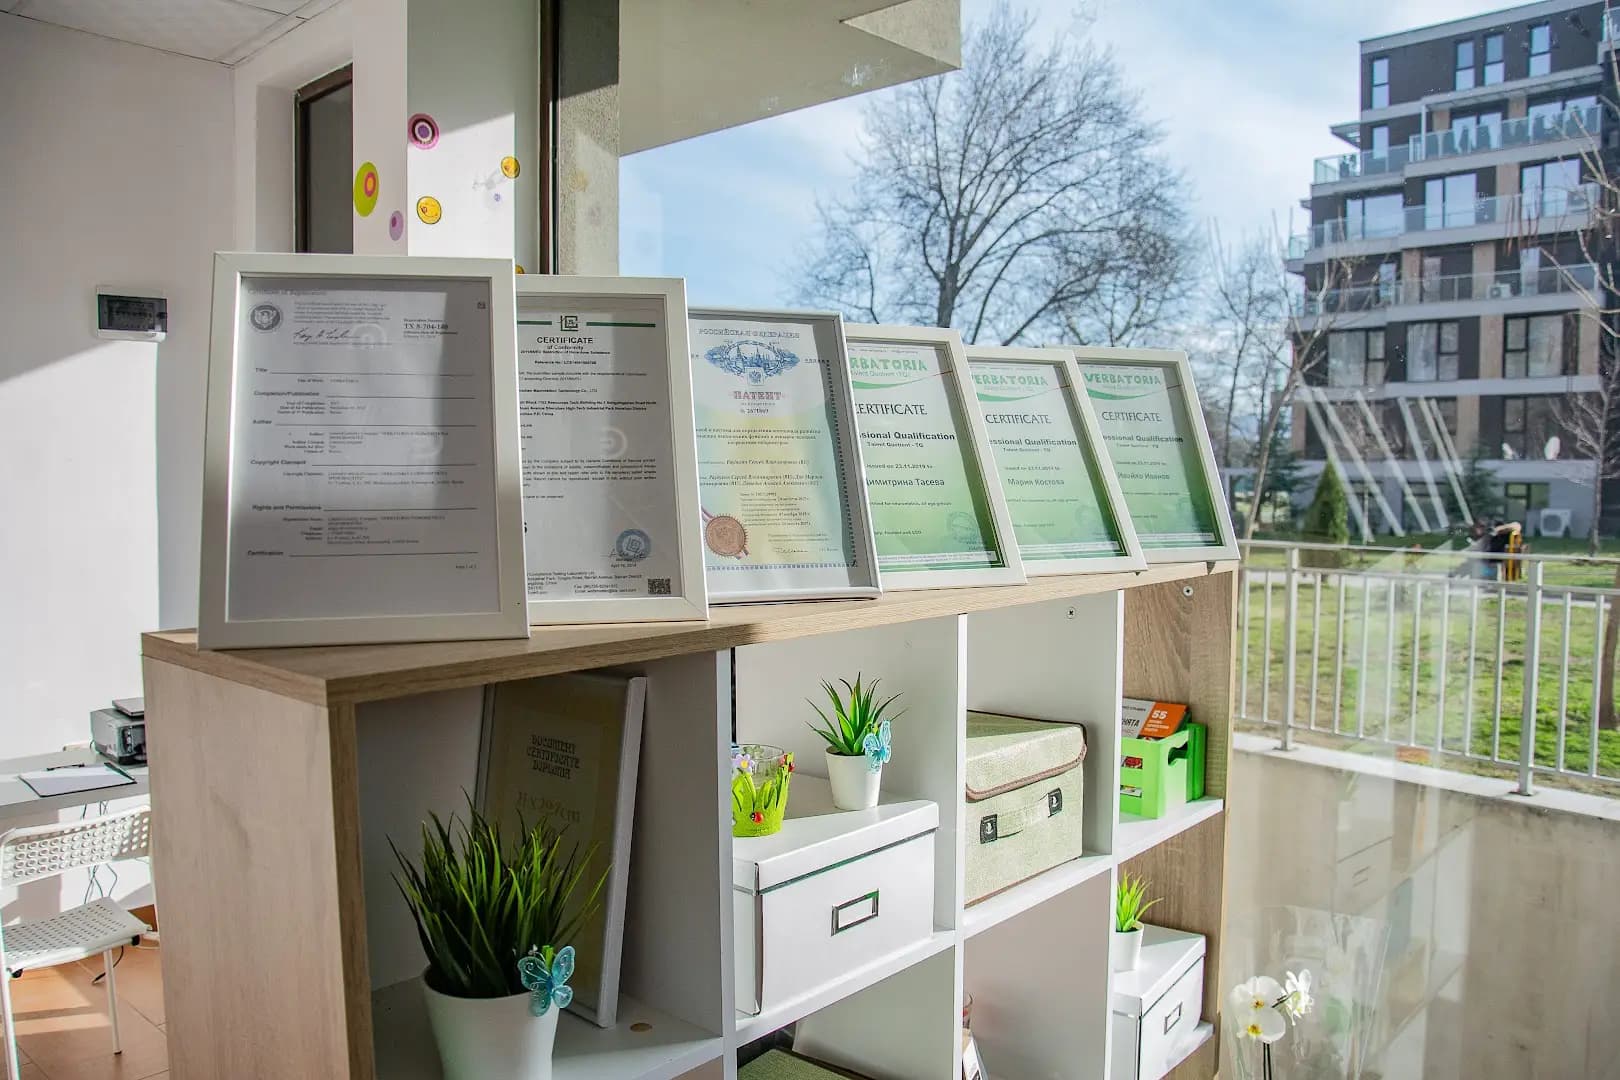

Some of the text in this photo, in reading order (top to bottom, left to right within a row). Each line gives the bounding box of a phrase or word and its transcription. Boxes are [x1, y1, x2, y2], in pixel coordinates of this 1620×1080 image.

[536, 336, 593, 344] CERTIFICATE
[972, 374, 1048, 386] ERBATORIA
[985, 414, 1052, 425] CERTIFICATE
[1101, 412, 1162, 422] CERTIFICATE
[894, 431, 955, 440] Qualification
[1024, 438, 1077, 447] Qualification
